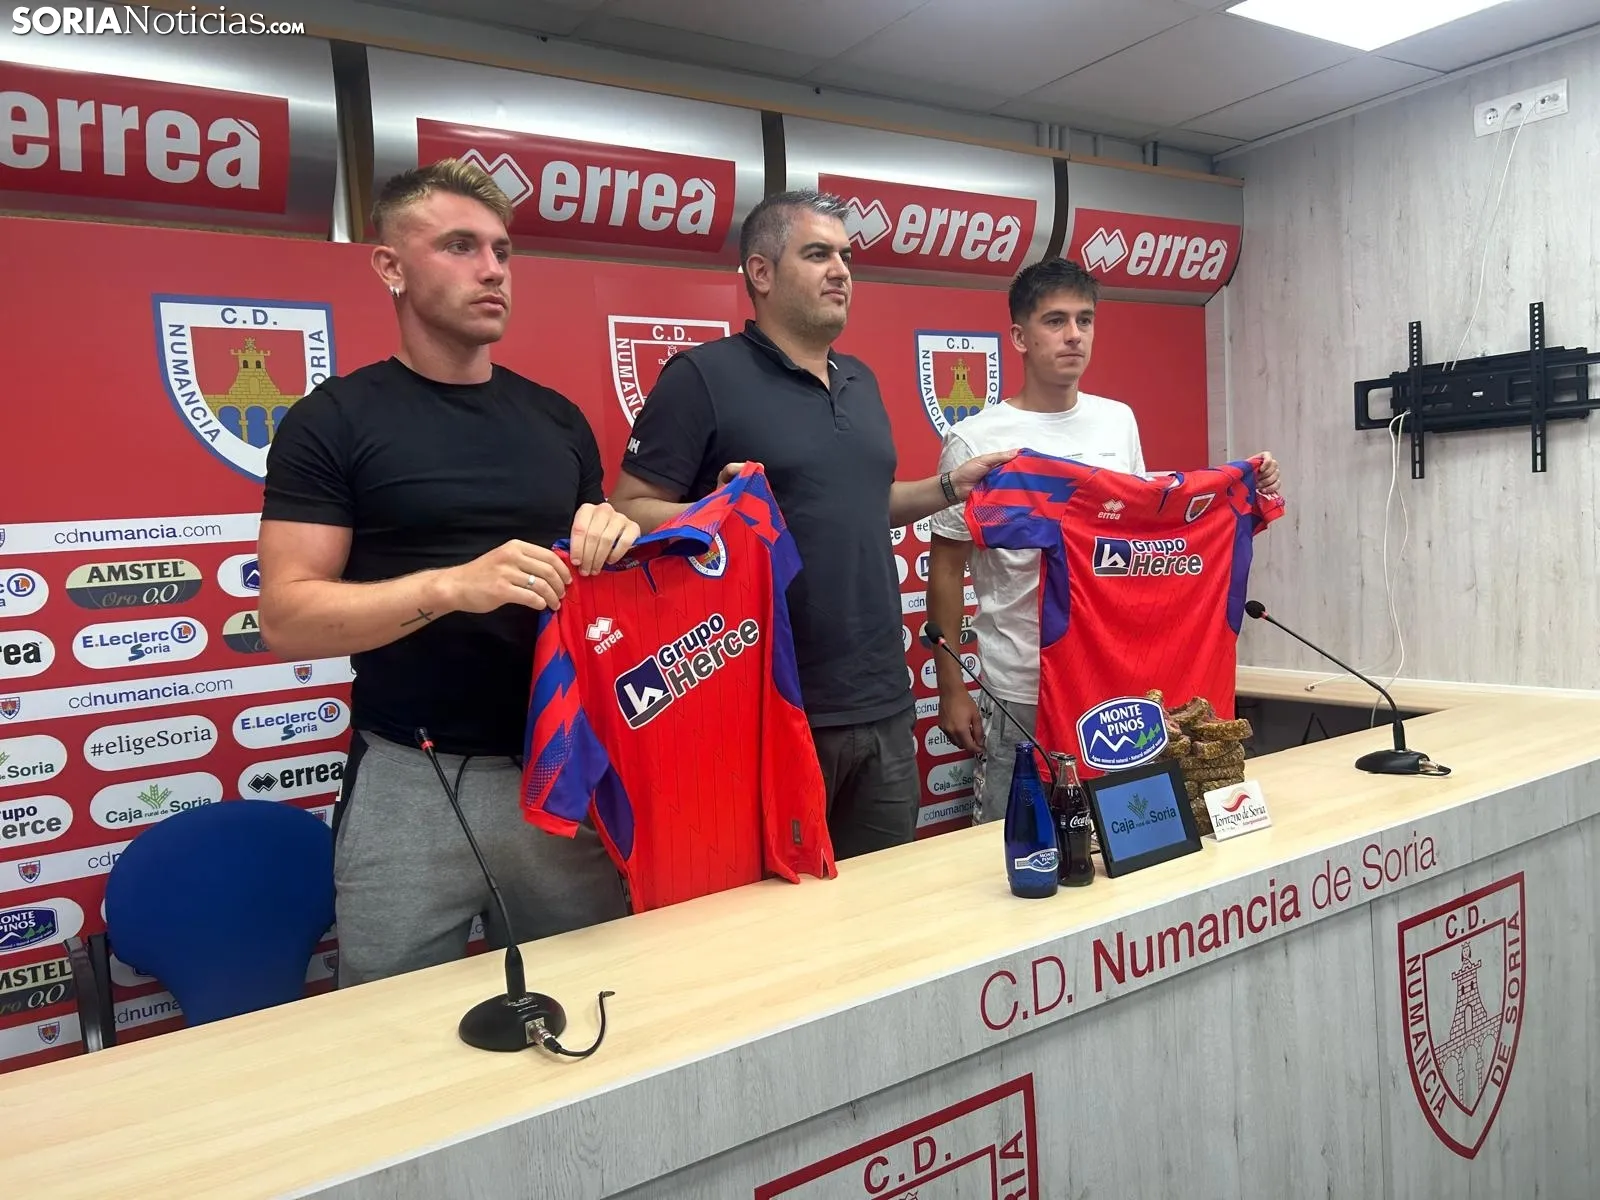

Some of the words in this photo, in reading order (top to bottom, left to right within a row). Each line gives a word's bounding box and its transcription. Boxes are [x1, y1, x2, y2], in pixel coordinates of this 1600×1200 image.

[220, 307, 278, 326] C.D.
[652, 325, 692, 342] C.D.
[946, 337, 975, 350] C.D.
[308, 329, 328, 387] ORIA
[168, 323, 222, 443] NUMANCIA
[616, 337, 643, 421] NUMANC
[987, 351, 998, 405] SORIA
[921, 350, 946, 432] NUMANCIA
[54, 522, 222, 545] cdnumancia.com
[1131, 538, 1186, 555] Grupo
[1131, 554, 1202, 576] Herce
[102, 592, 137, 607] Oro
[82, 630, 169, 648] E.Leclerc
[594, 628, 625, 655] errea
[657, 612, 726, 669] Grupo
[128, 643, 171, 662] Soria
[666, 619, 760, 698] Herce
[68, 677, 233, 709] cdnumancia.com
[241, 710, 317, 730] E.Leclerc
[1099, 704, 1143, 725] MONTE
[281, 723, 318, 741] Soria
[1107, 717, 1145, 737] PINOS
[90, 725, 213, 758] #eligeSoria
[7, 761, 55, 778] Soria
[2, 805, 38, 822] upo
[105, 808, 143, 823] Caja
[1111, 818, 1135, 834] Caja
[1149, 806, 1177, 823] Soria
[1, 817, 62, 840] erce
[0, 910, 35, 924] ONTE
[1445, 905, 1486, 940] C.D.
[979, 956, 1074, 1031] C.D.
[1092, 878, 1301, 993] Numancia
[1311, 860, 1351, 910] de
[1362, 830, 1437, 891] Soria
[1504, 909, 1521, 1025] SORIA
[1406, 953, 1447, 1119] NUMANCIA
[863, 1135, 951, 1195] C.D.
